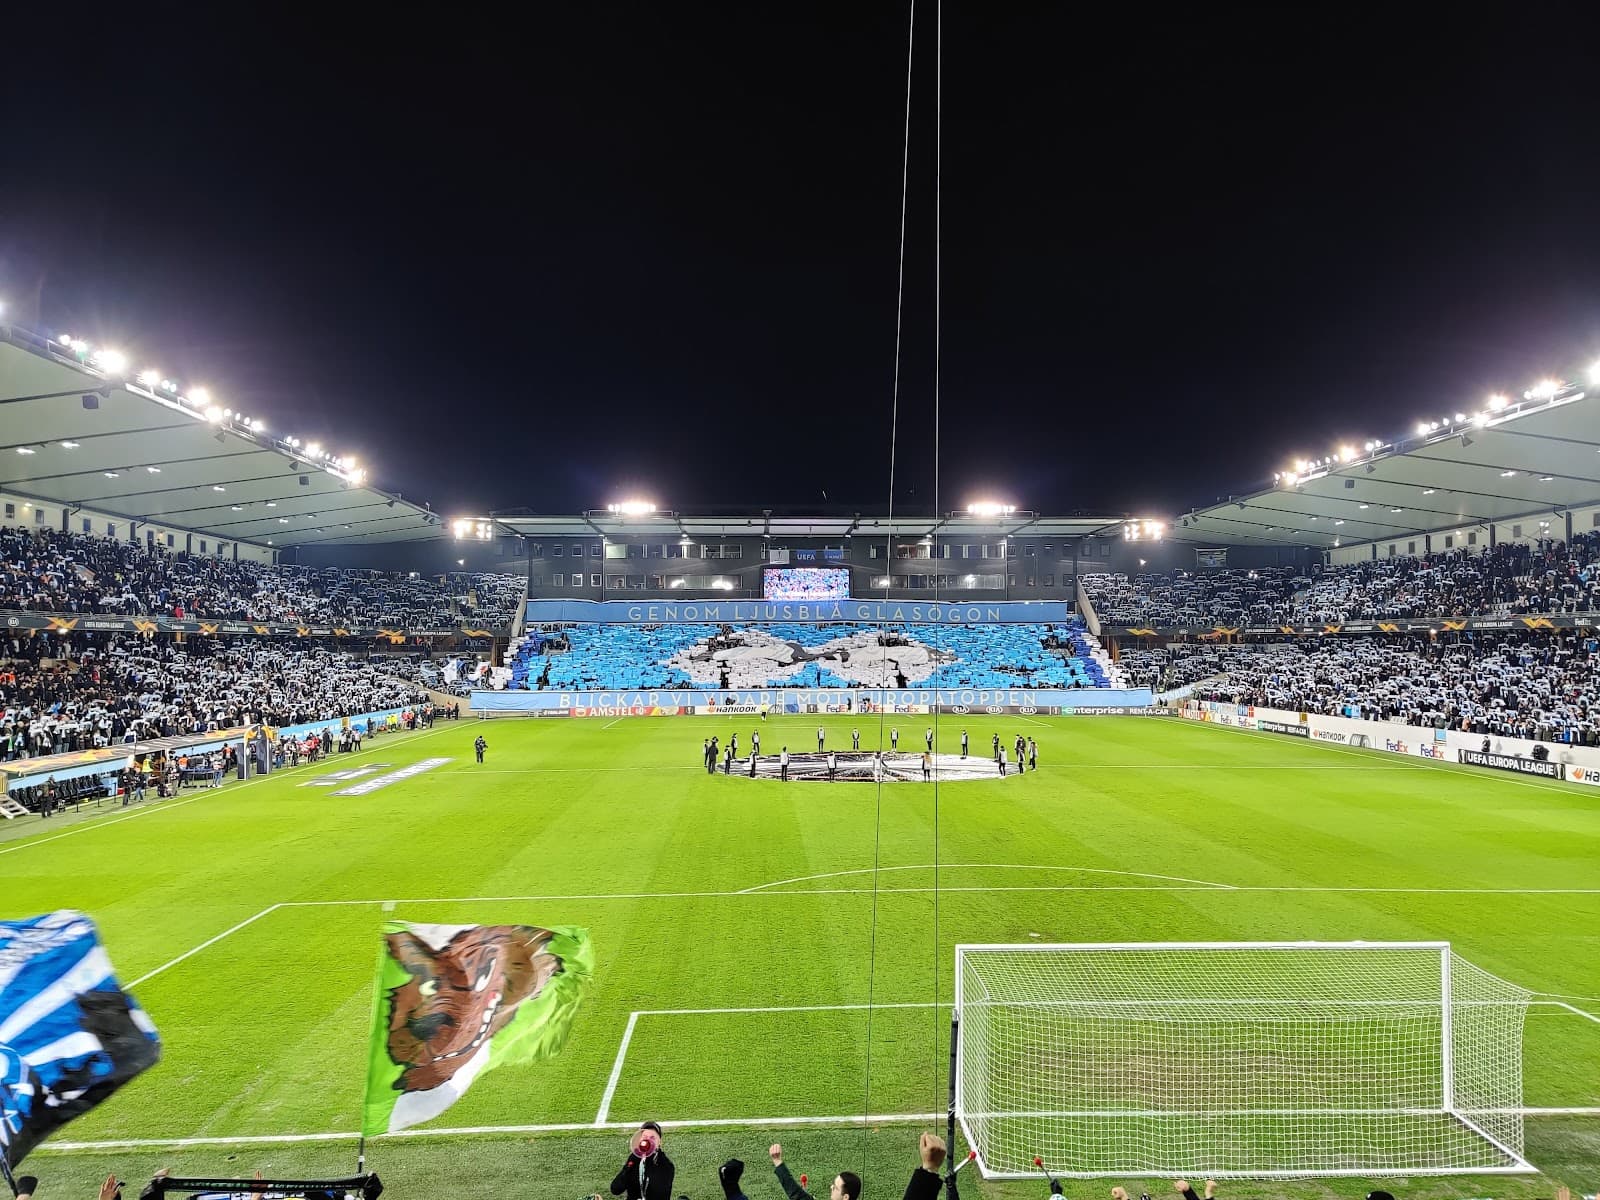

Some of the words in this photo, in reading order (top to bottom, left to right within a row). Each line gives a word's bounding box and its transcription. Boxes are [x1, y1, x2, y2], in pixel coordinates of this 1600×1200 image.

[628, 606, 720, 621] GENOM
[735, 602, 842, 620] LJUSBLÅ
[857, 604, 1000, 622] GLASÖGON
[560, 693, 660, 708] BLICKAR
[671, 692, 691, 705] VI
[797, 691, 845, 705] MOT
[858, 691, 1036, 706] EUROPATOPPEN
[590, 706, 633, 717] AMSTEL
[894, 704, 919, 713] FedEx
[953, 704, 968, 713] KIA
[986, 704, 1002, 713] KIA
[1021, 704, 1036, 713] KIA
[1066, 706, 1124, 715] enterprise
[1129, 707, 1169, 715] RENT-A-CAR
[1386, 738, 1408, 753] FedEx
[1420, 743, 1444, 759] FedEx
[1467, 752, 1488, 765] UEFA
[1488, 756, 1520, 770] EUROPA
[1520, 760, 1555, 776] LEAGUE
